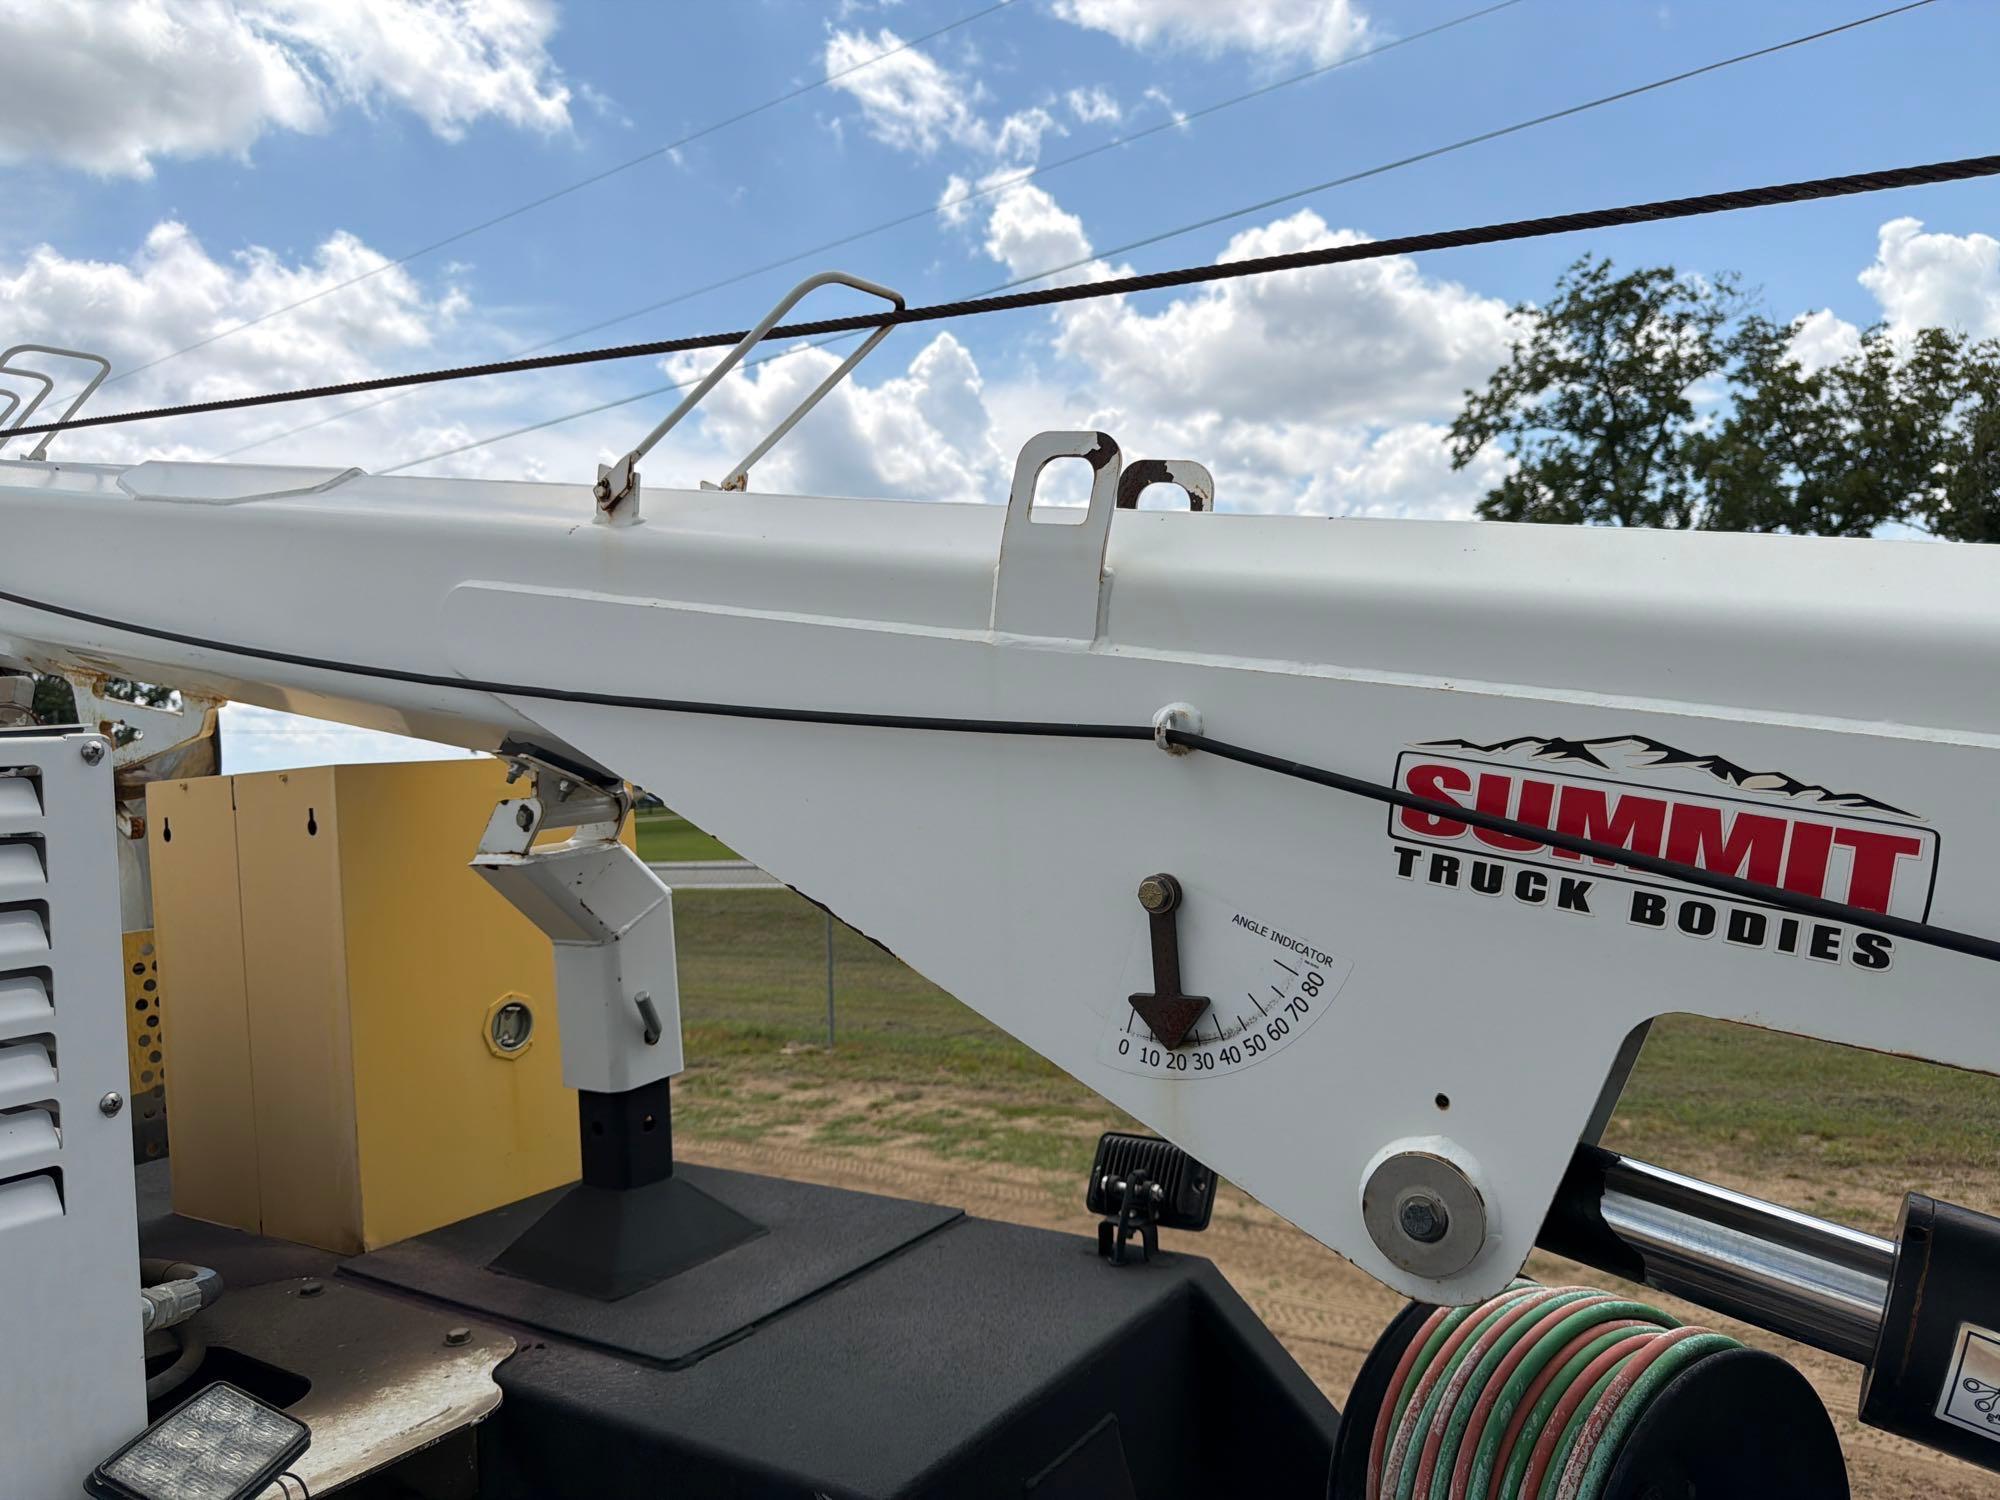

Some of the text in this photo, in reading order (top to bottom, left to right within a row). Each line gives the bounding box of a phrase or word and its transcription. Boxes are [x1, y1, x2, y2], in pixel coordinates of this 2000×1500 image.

[1400, 764, 1921, 916] SUMMIT
[1232, 914, 1333, 968] ANGLE INDICATOR
[1394, 847, 1893, 970] TRUCK BODIES
[1118, 971, 1325, 1071] 0 10 20 30 40 50 60 70 80
